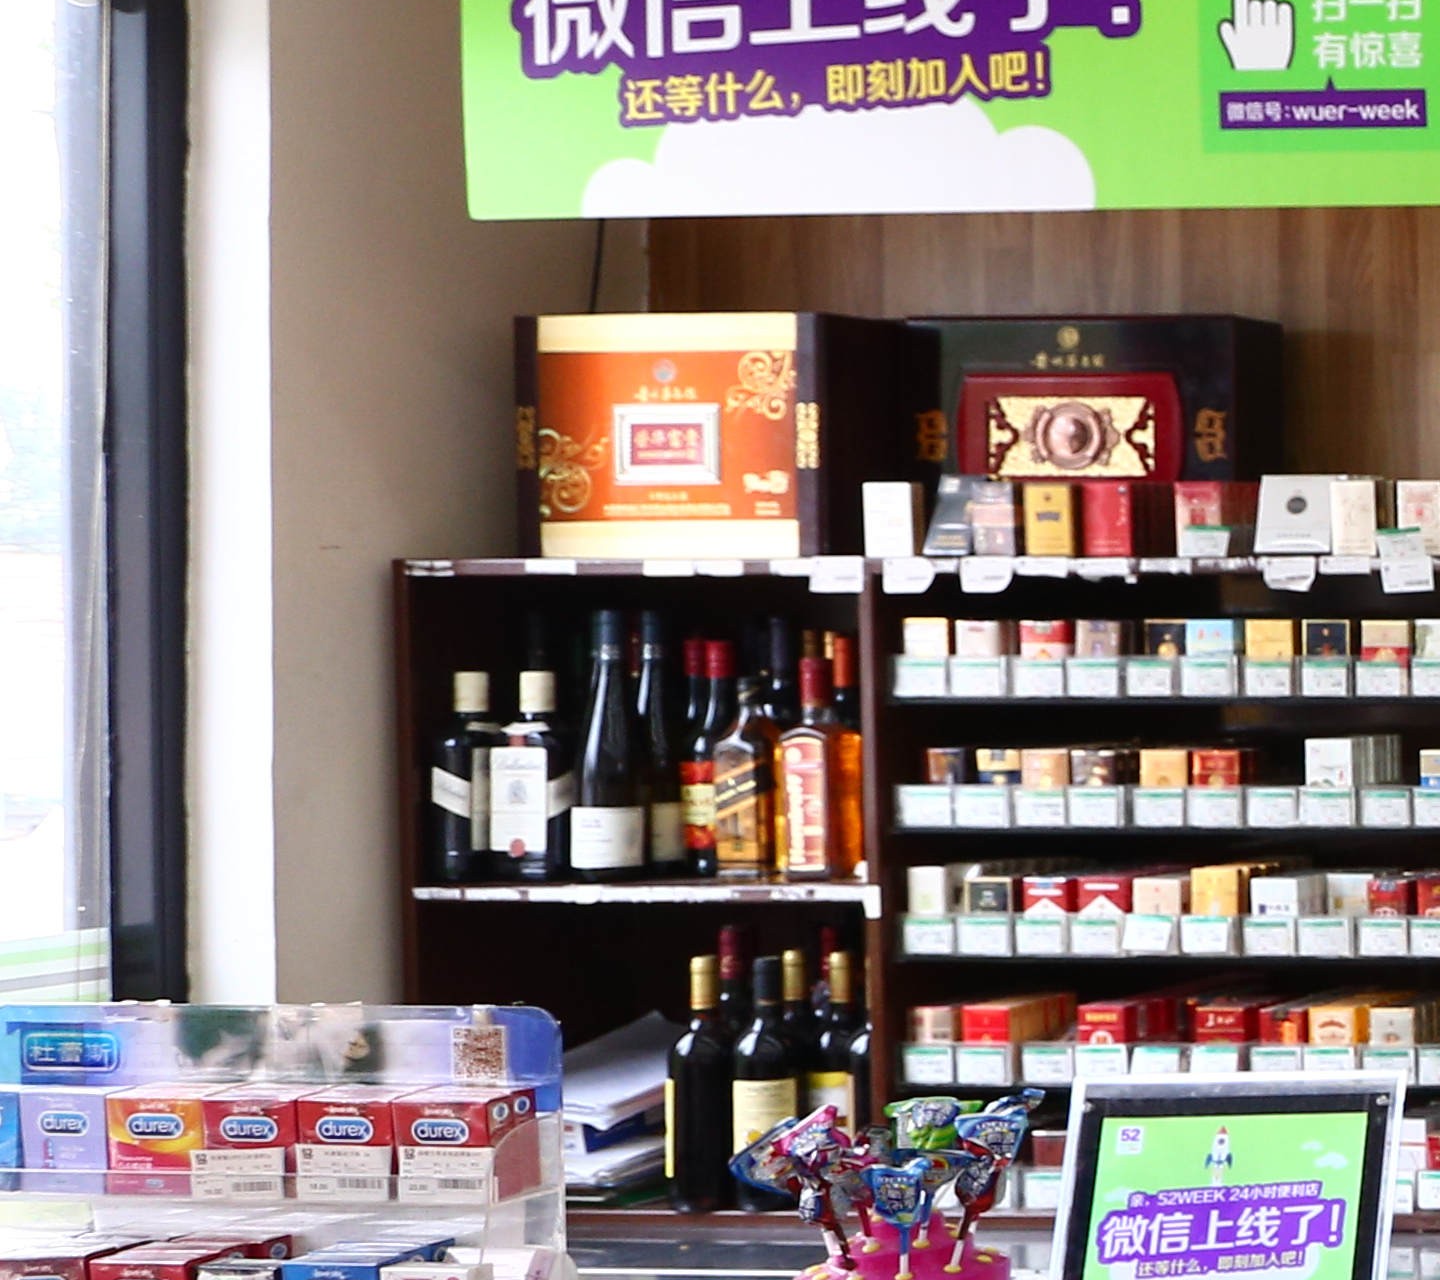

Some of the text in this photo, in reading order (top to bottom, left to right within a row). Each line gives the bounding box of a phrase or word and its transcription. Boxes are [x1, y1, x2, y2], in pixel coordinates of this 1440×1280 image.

[1312, 32, 1424, 70] 有惊喜
[42, 1114, 88, 1132] durex
[130, 1115, 182, 1136] durex
[414, 1121, 467, 1143] durex
